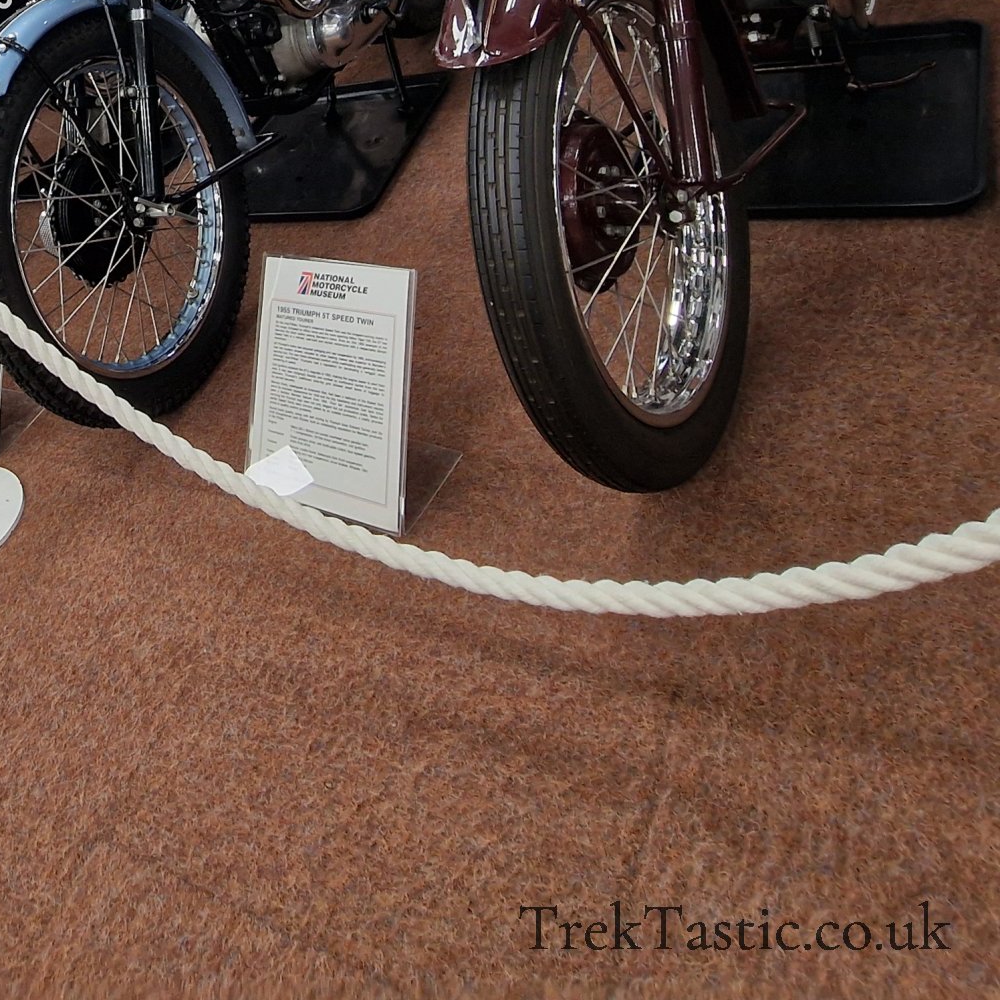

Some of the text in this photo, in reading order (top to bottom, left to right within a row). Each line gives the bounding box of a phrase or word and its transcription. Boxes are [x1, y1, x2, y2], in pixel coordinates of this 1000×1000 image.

[313, 273, 355, 284] NATIONAL
[312, 281, 368, 294] MOTORCYCLE
[310, 289, 346, 300] MUSEUM
[277, 305, 291, 314] 1955
[292, 307, 321, 319] TRIUMPH
[331, 313, 355, 324] SPEED
[356, 317, 375, 327] TWIN
